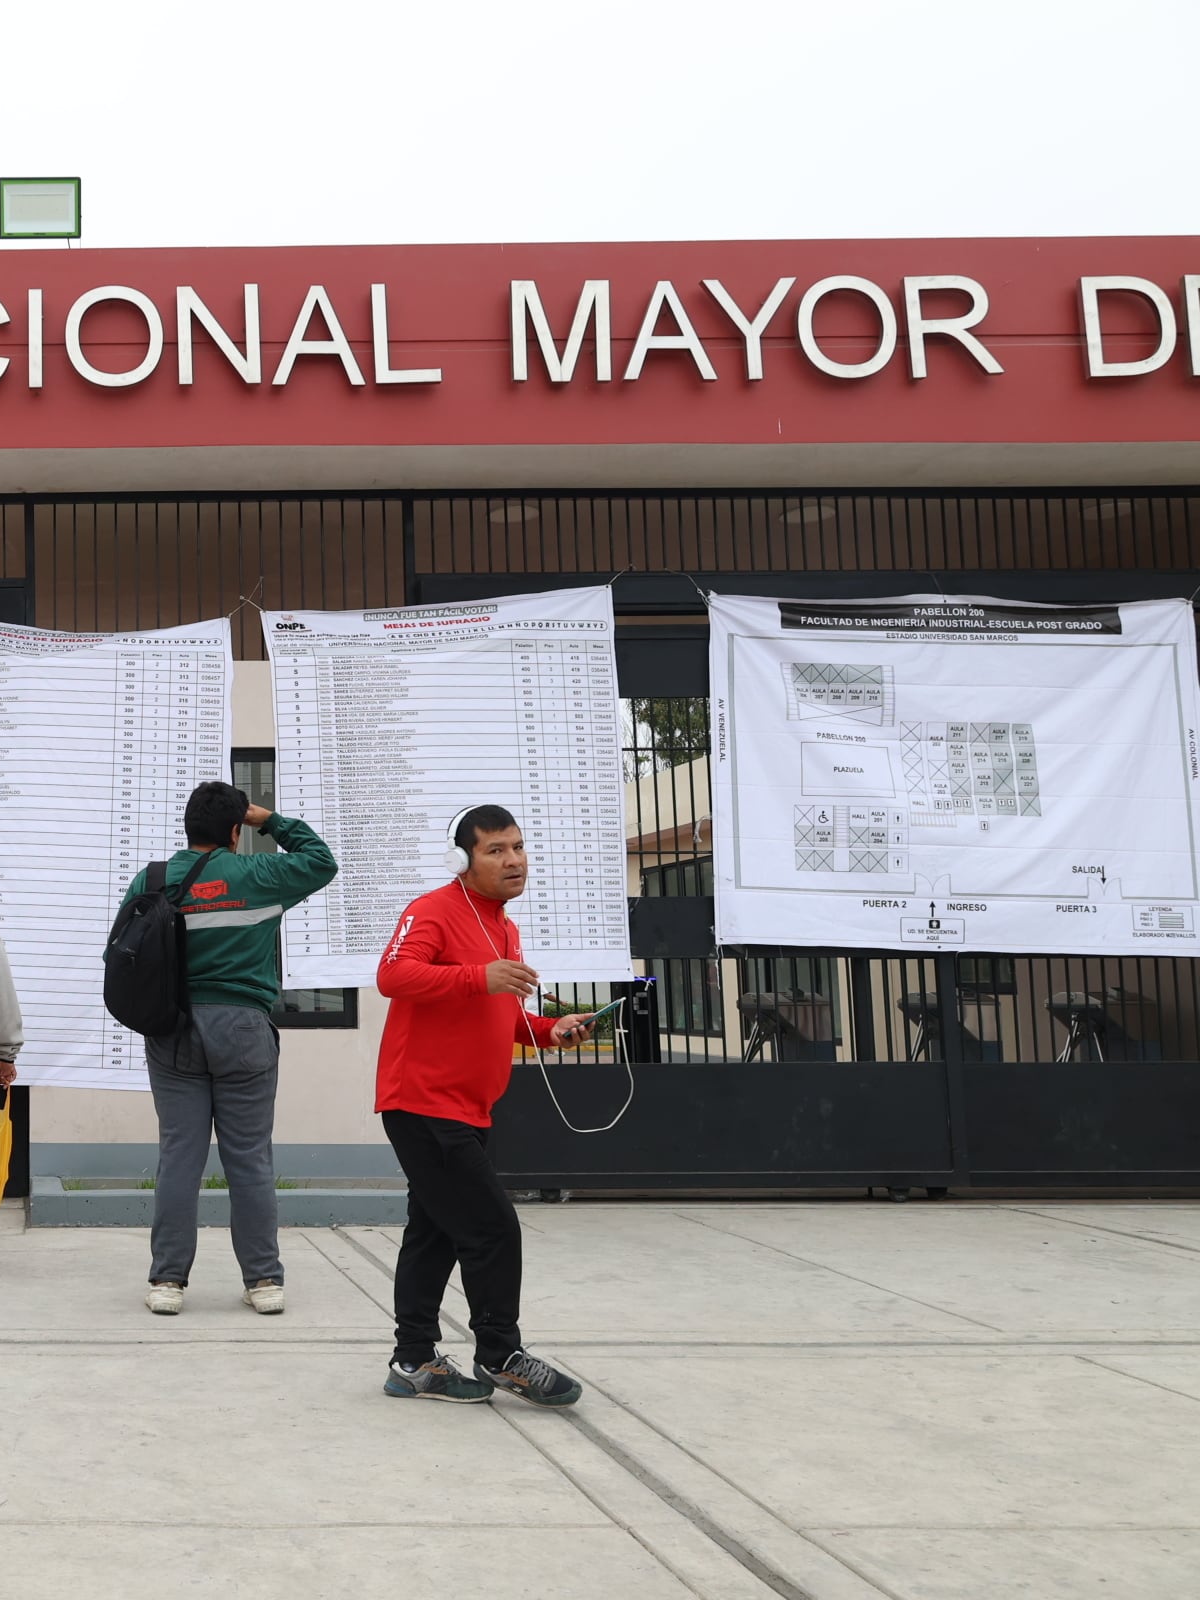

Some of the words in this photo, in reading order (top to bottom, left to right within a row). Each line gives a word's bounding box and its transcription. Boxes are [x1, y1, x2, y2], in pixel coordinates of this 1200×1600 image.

[509, 274, 1005, 383] MAYOR
[1078, 273, 1200, 379] D
[365, 613, 399, 621] ¡NUNCA
[400, 611, 418, 619] FUE
[419, 610, 437, 618] TAN
[438, 607, 464, 616] FÁCIL
[464, 605, 497, 614] VOTAR!
[914, 608, 967, 616] PABELLON
[275, 622, 306, 631] ONPE
[383, 622, 416, 630] MESAS
[437, 616, 491, 626] SUFRAGIO
[800, 616, 851, 626] FACULTAD
[853, 618, 869, 626] DE
[870, 618, 927, 627] INGENIERIA
[929, 619, 1035, 629] INDUSTRIAL-ESCUELA
[1036, 621, 1062, 629] POST
[1065, 621, 1102, 630] GRADO
[718, 698, 725, 709] AV
[816, 732, 854, 741] PABELLON
[1188, 728, 1195, 740] AV
[1189, 741, 1199, 780] COLONIAL
[1072, 866, 1102, 874] SALIDA
[862, 900, 900, 908] PUERTA
[902, 900, 907, 908] 2
[946, 904, 987, 912] INGRESO
[1056, 904, 1090, 913] PUERTA
[1092, 906, 1097, 914] 3
